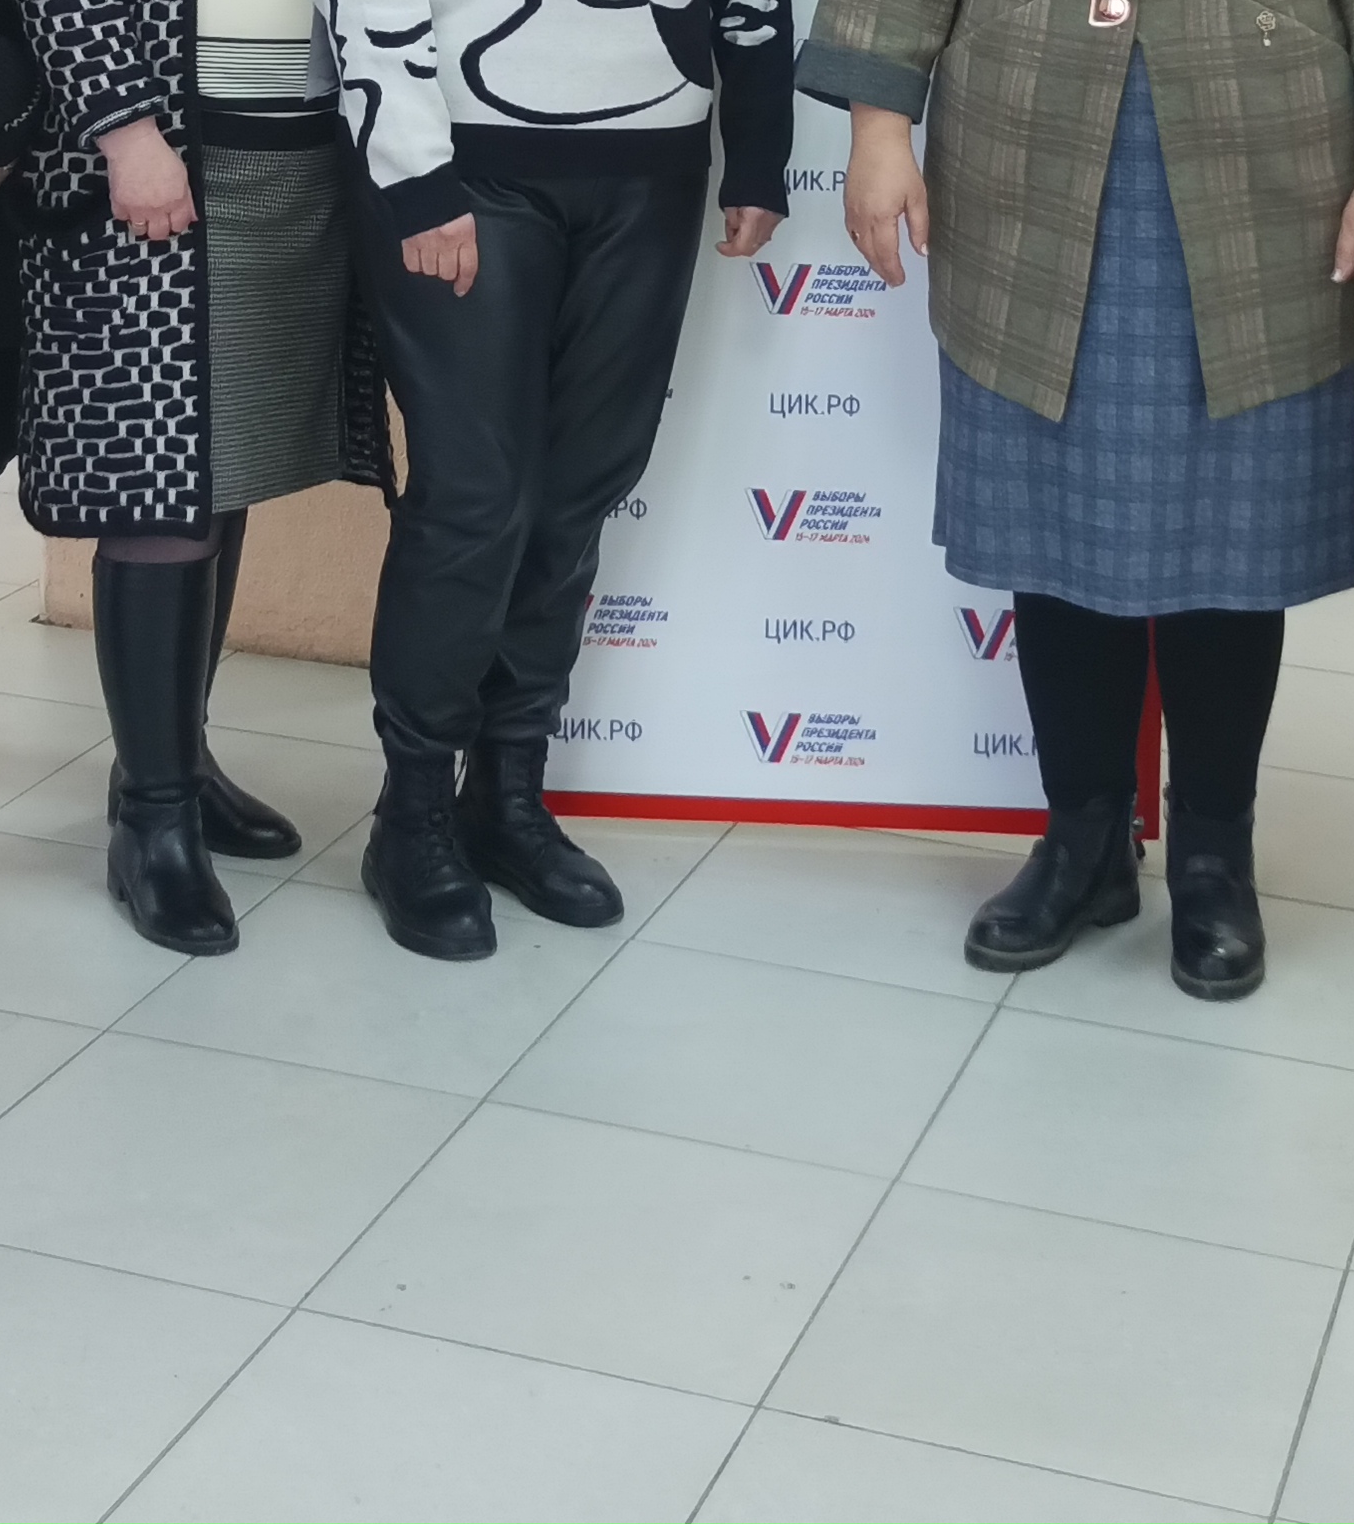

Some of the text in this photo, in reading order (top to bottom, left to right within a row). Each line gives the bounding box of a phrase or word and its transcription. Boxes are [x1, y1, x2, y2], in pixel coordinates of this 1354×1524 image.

[786, 169, 846, 195] ИК.Р
[817, 265, 871, 276] ВЫБОРЫ
[811, 279, 887, 292] ПРЕЗИДЕНТА
[804, 293, 853, 304] РОССИИ
[770, 392, 860, 418] ЦИК.РФ
[812, 490, 867, 502] ВЫБОРЫ
[806, 504, 882, 517] ПРЕЗИДЕНТА
[799, 519, 849, 530] РОССИИ
[599, 594, 653, 607] ВЫБОРЫ
[594, 608, 668, 621] ПРЕЗИДЕНТА
[587, 623, 636, 634] РОССИИ
[765, 618, 855, 644] ЦИК.РФ
[808, 713, 862, 725] ВЫБОРЫ
[801, 727, 877, 740] ПРЕЗИДЕНТА
[794, 741, 844, 753] РОССИИ
